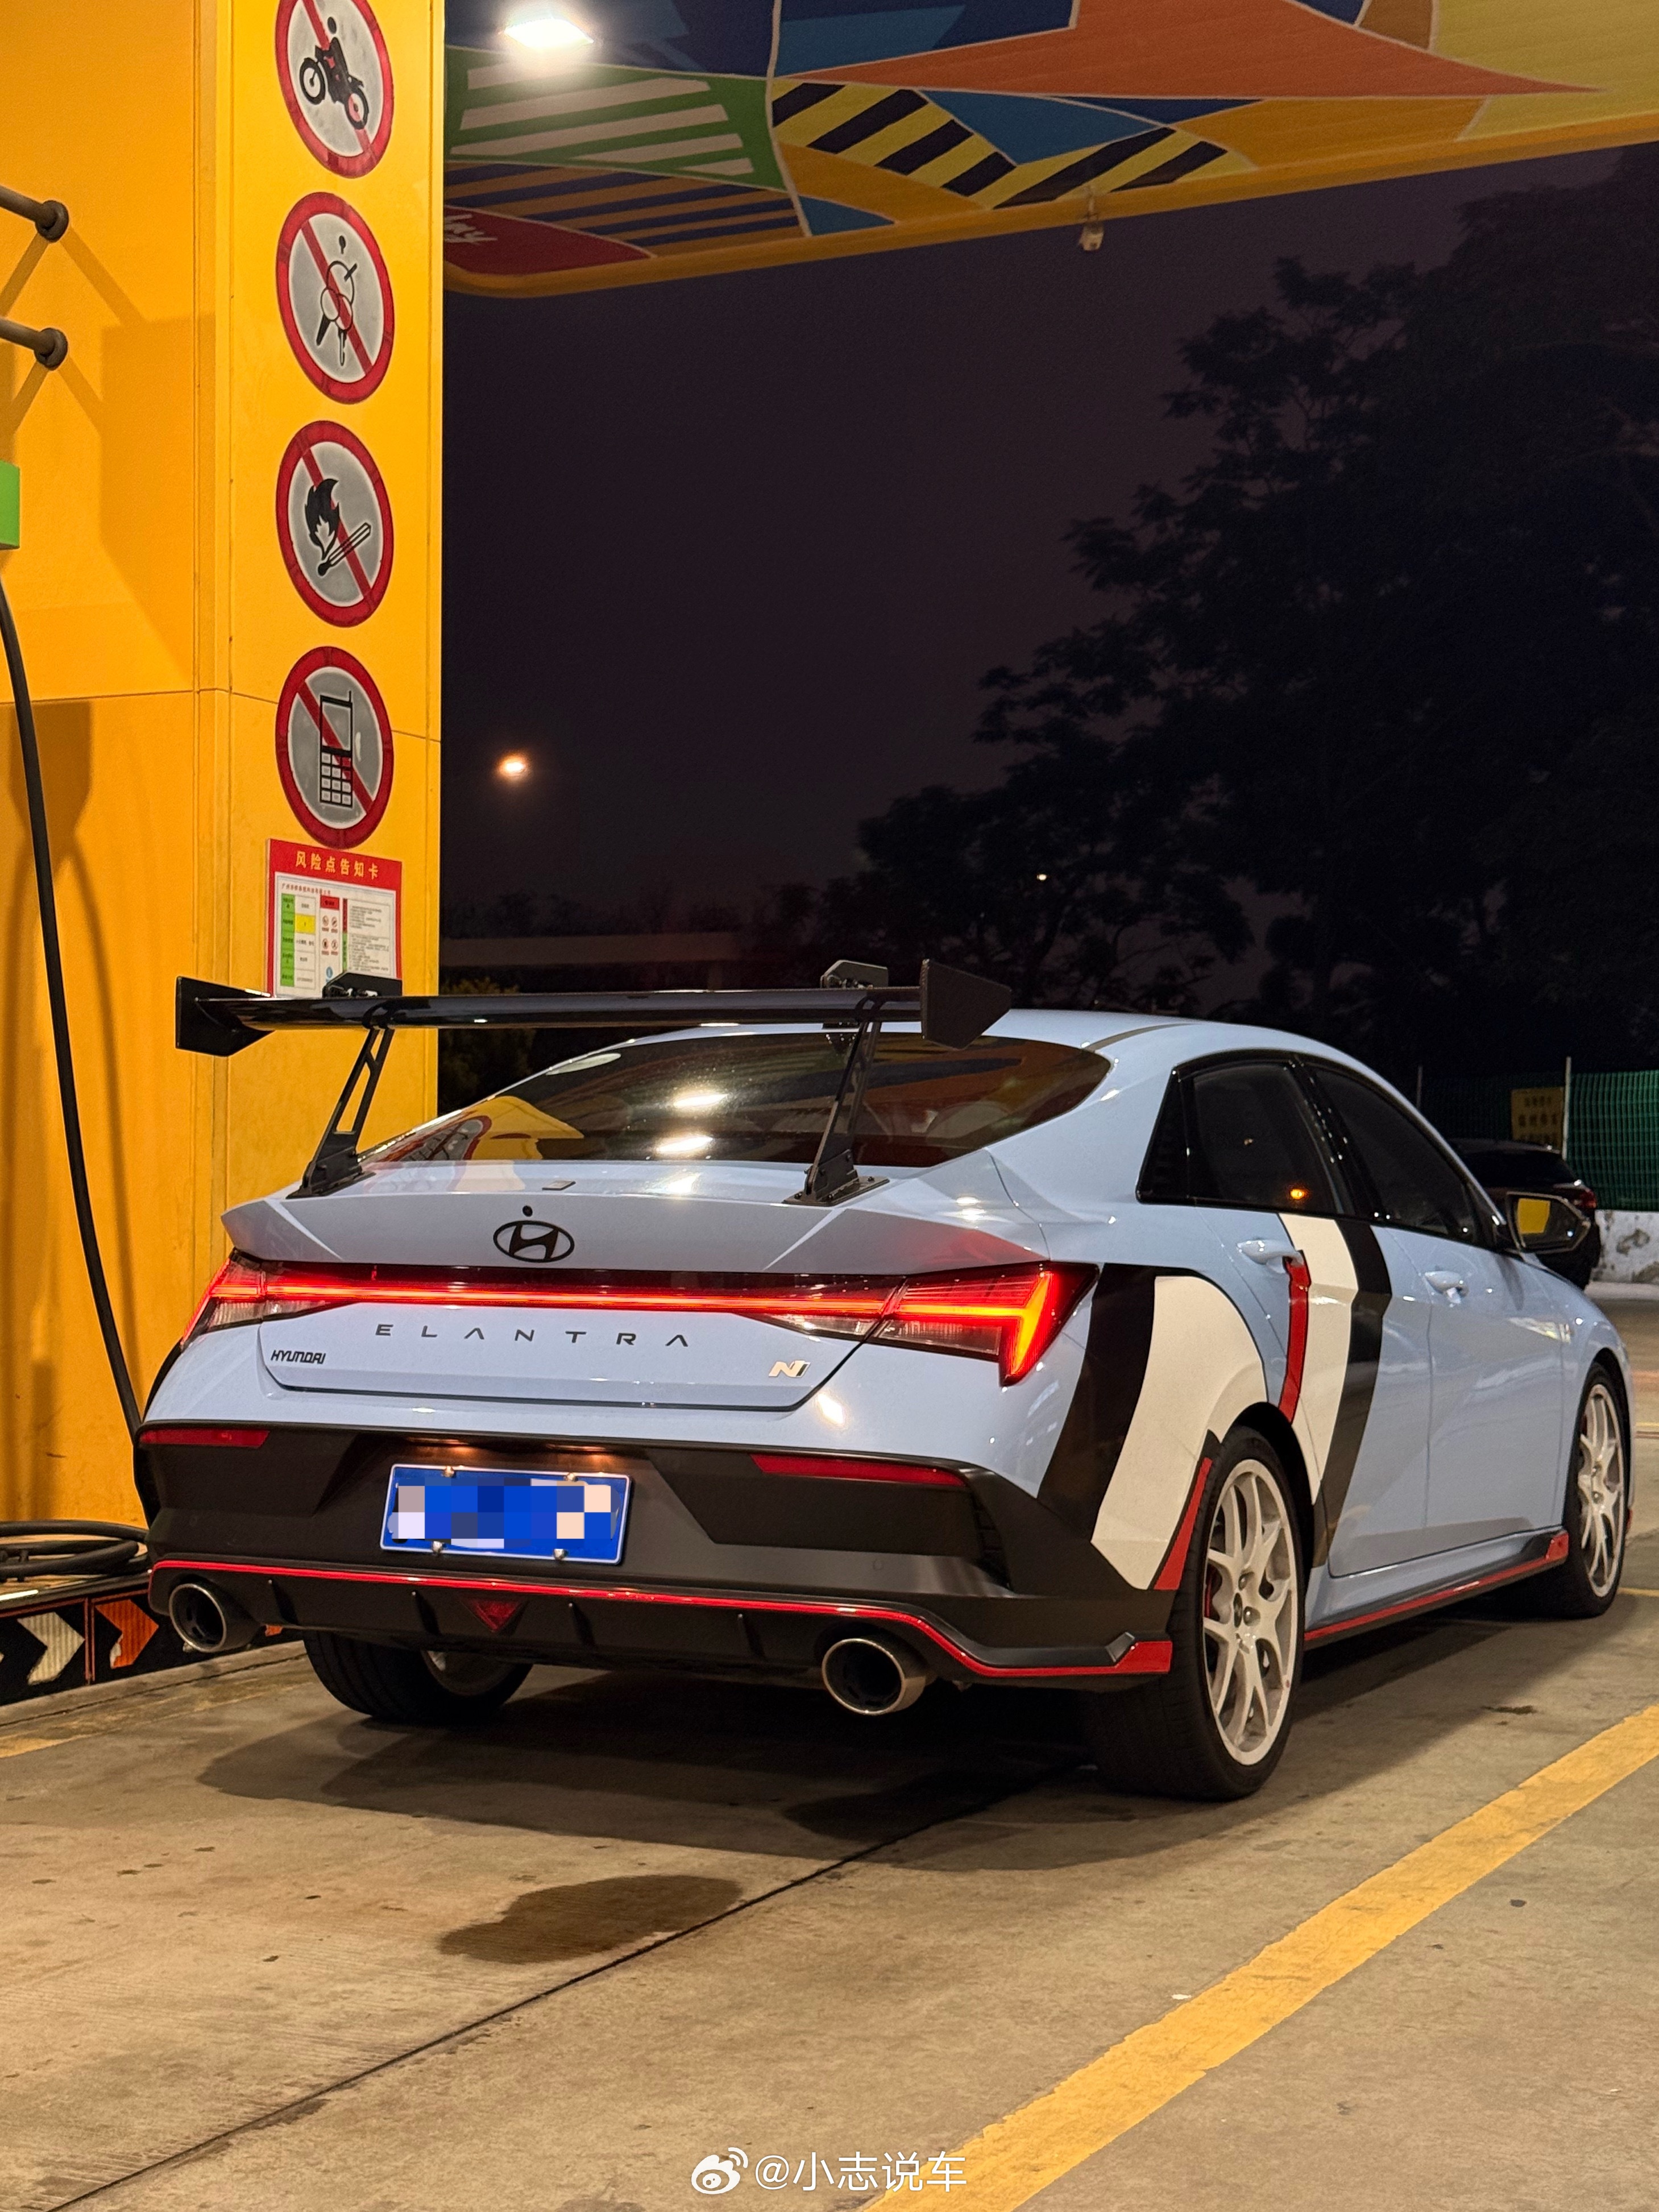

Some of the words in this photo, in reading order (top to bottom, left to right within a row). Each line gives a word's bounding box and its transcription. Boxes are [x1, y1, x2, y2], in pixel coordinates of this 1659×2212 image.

[295, 850, 379, 880] 风险点告知卡
[375, 1323, 689, 1347] ELANTRA
[270, 1349, 326, 1364] HYUNDAI
